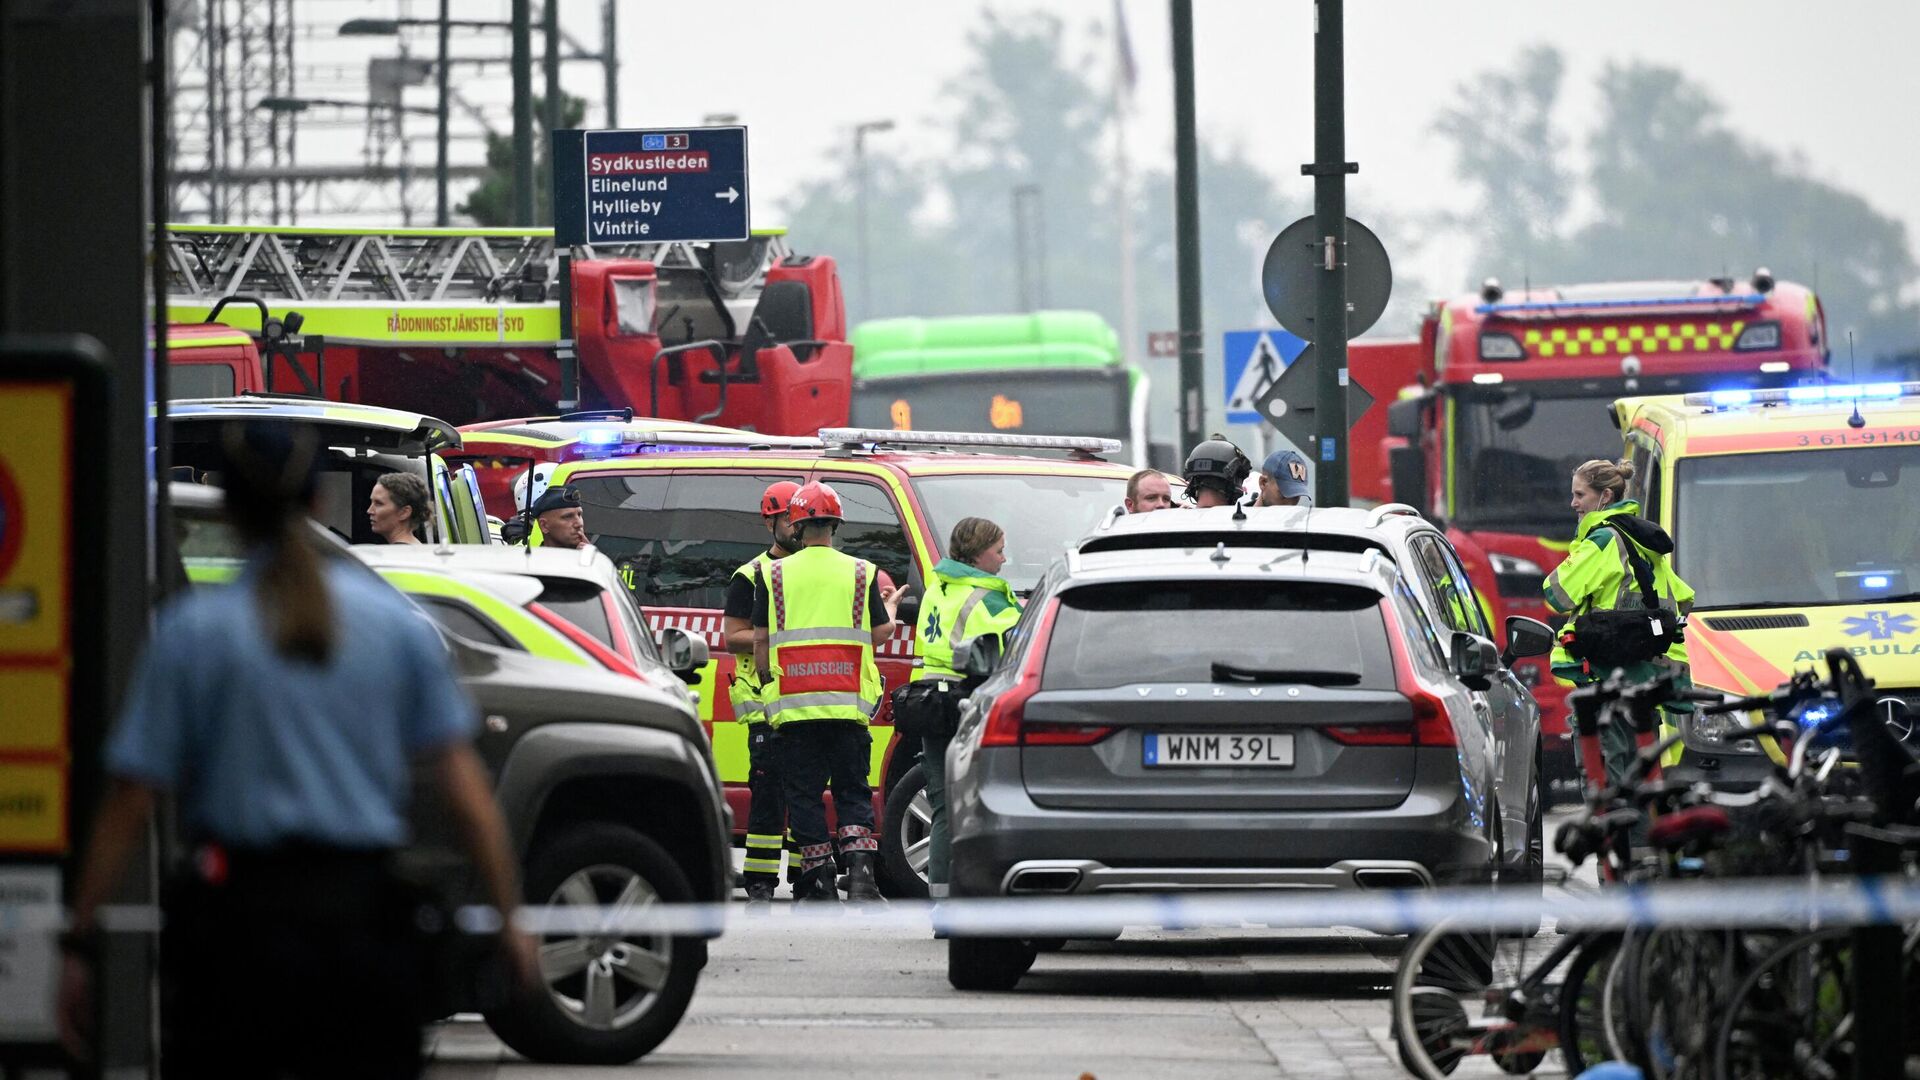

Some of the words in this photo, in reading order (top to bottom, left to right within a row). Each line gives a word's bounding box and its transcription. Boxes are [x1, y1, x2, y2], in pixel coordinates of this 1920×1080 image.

[672, 136, 680, 147] 3
[591, 156, 707, 173] Sydkustleden
[592, 176, 668, 193] Elinelund
[593, 200, 662, 216] Hyllieby
[593, 220, 650, 235] Vintrie
[386, 313, 498, 332] RÄDDNINGSTJÄNSTEN
[504, 316, 525, 332] SYD
[1797, 434, 1810, 447] 3
[1288, 461, 1306, 482] W
[618, 563, 636, 590] ÄL
[787, 662, 855, 677] INSATSCHEF
[1137, 687, 1301, 697] VOLVO
[1167, 736, 1220, 761] WNM
[1230, 736, 1281, 761] 39L
